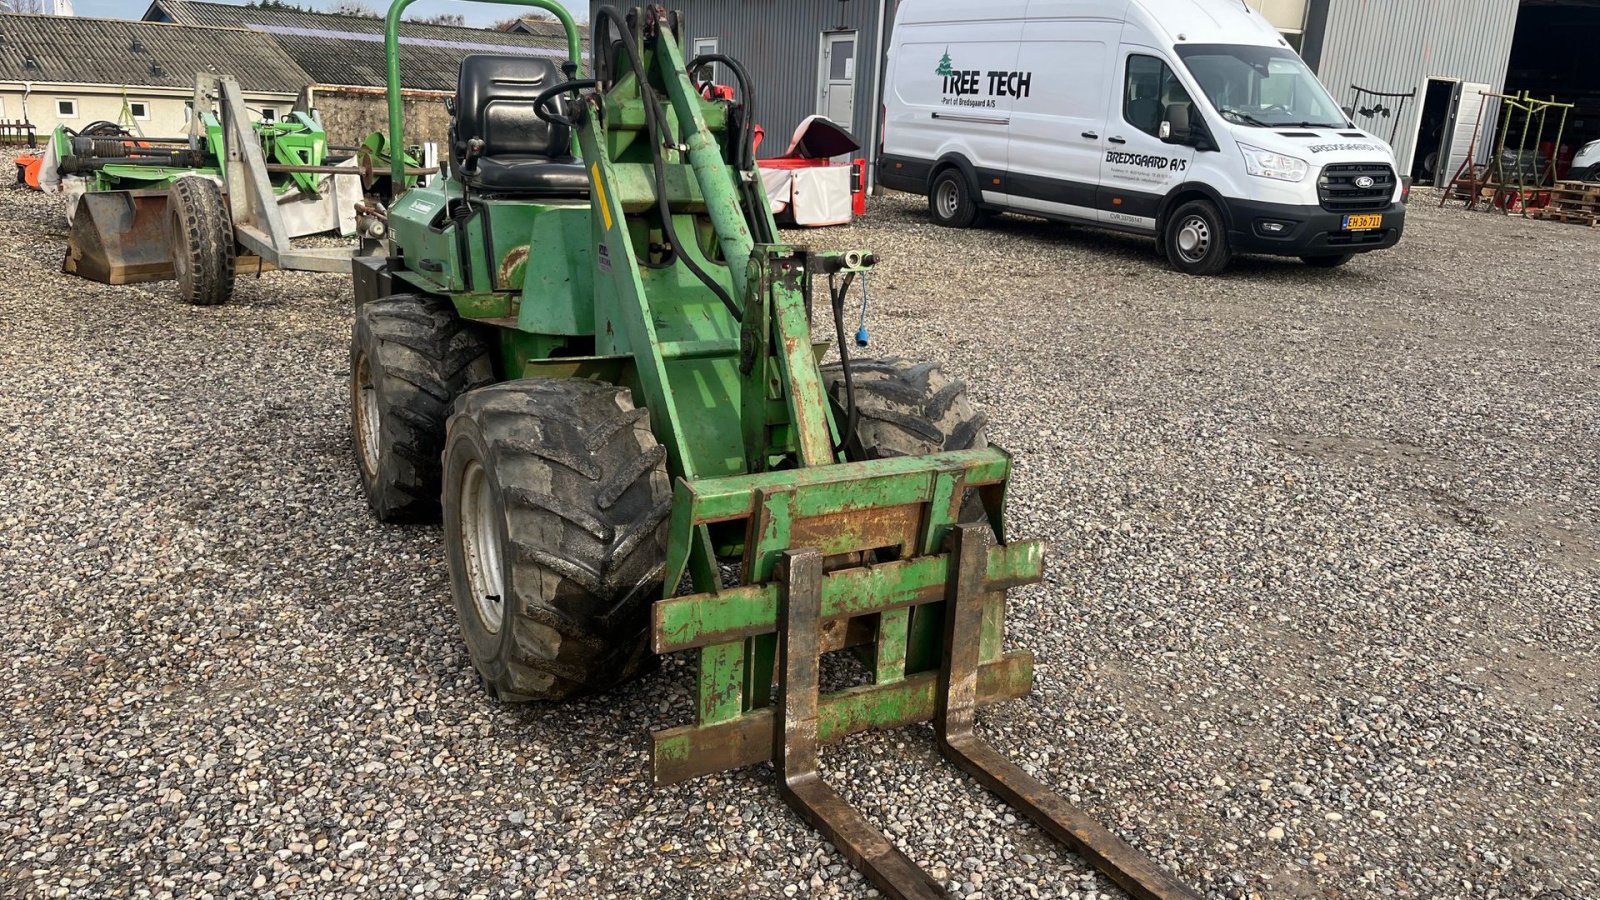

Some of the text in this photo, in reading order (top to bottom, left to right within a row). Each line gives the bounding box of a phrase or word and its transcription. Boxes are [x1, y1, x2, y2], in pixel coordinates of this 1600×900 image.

[942, 70, 1032, 100] TREE TECH
[959, 97, 986, 108] Bredsgaard
[986, 99, 996, 108] A/S
[1106, 151, 1168, 169] BREDSGAARD
[1170, 157, 1187, 172] A/S
[1347, 217, 1380, 227] EH 36 711
